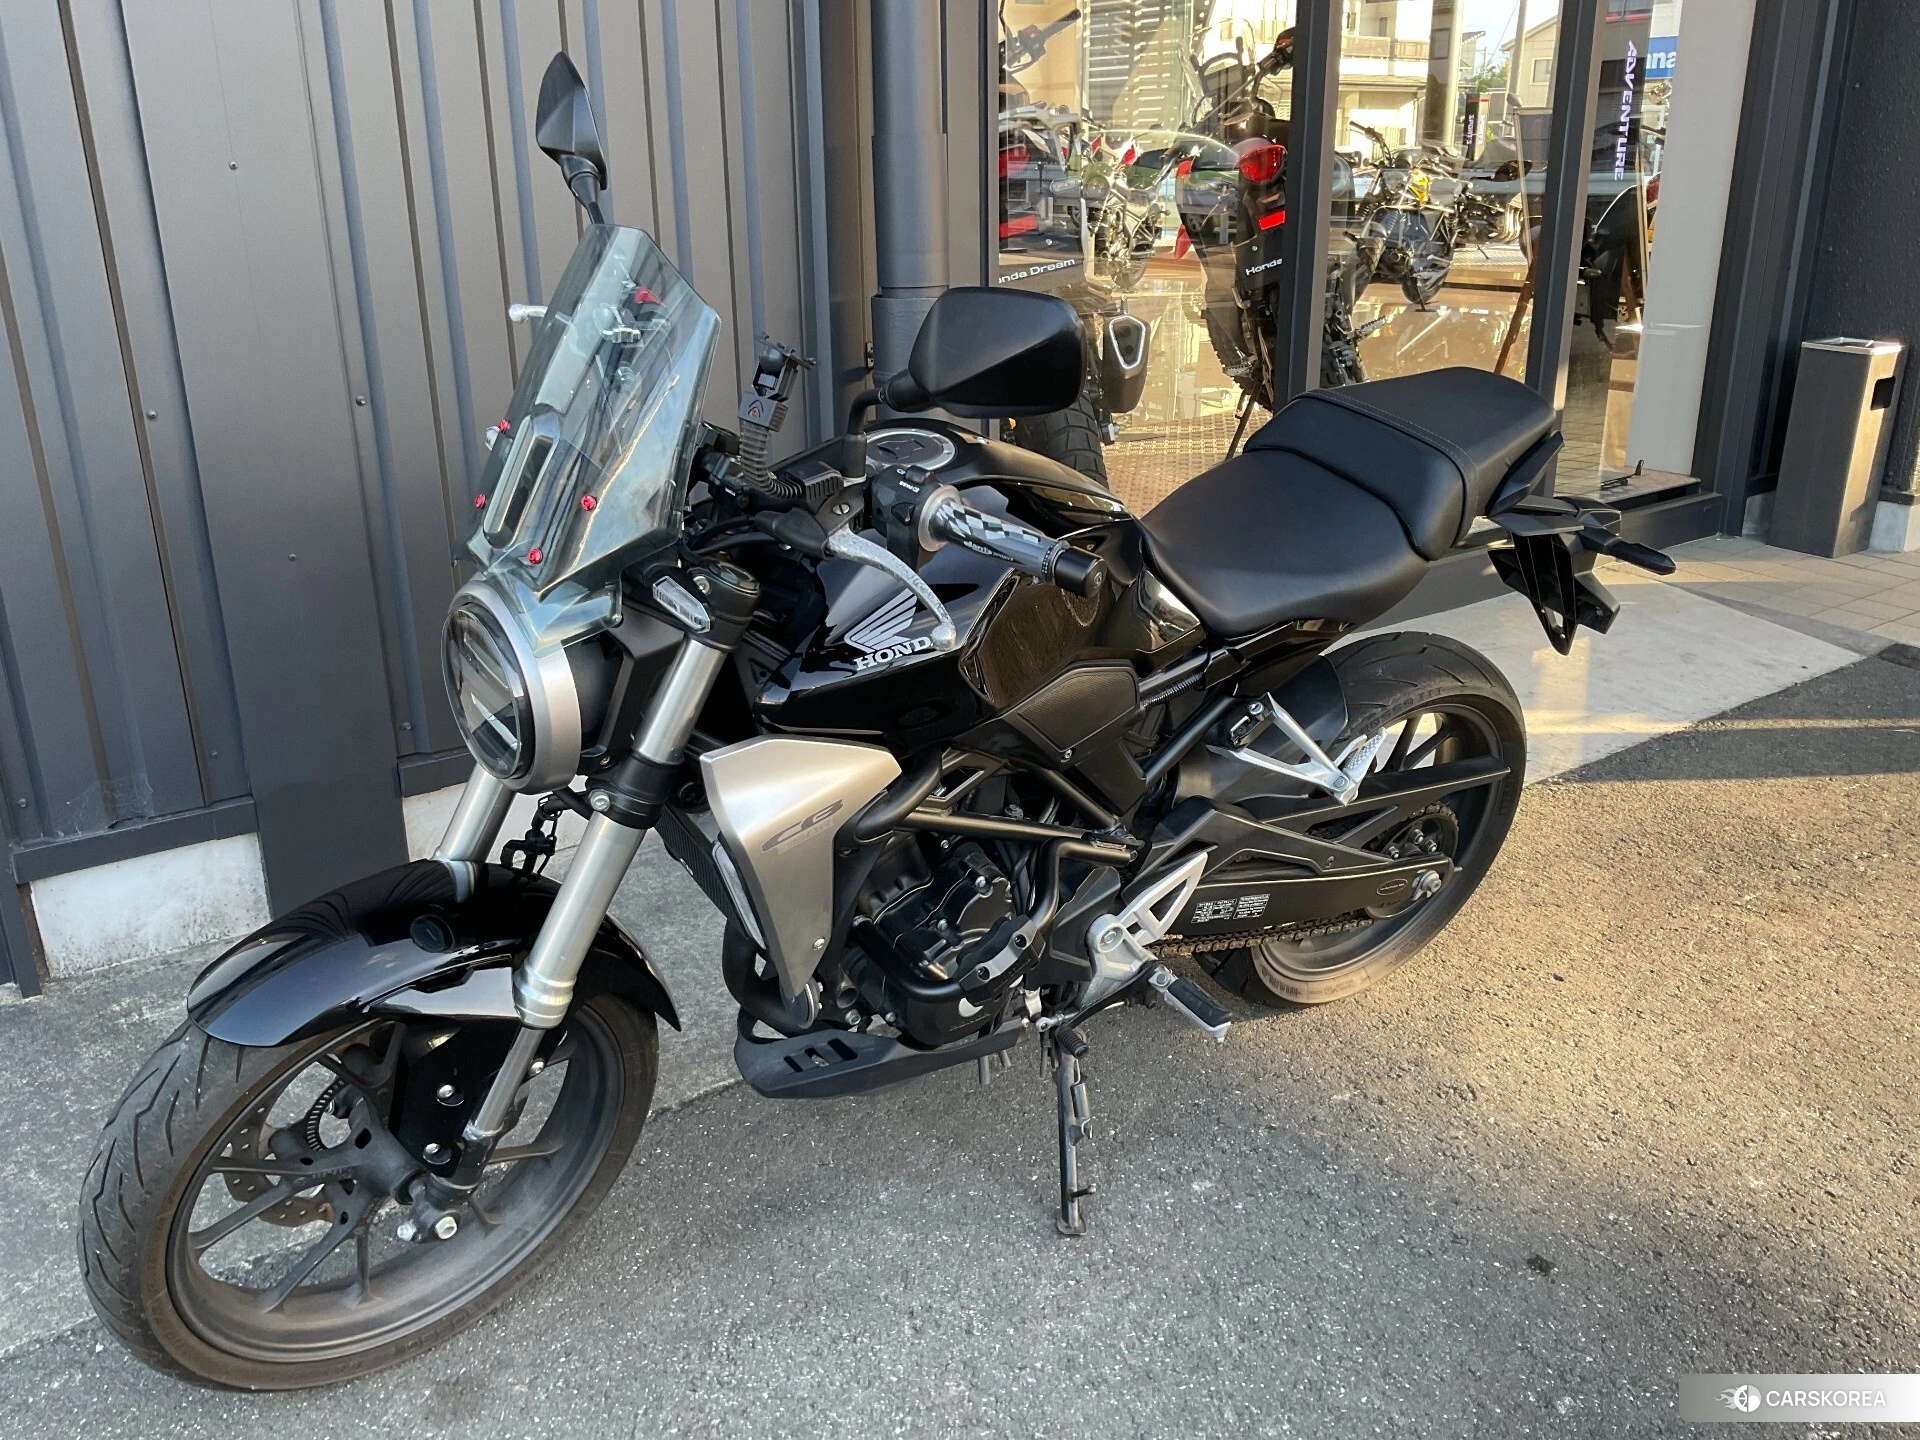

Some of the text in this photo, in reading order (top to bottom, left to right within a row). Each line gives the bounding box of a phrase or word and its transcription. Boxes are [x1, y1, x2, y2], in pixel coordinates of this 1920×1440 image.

[1614, 40, 1638, 181] ADVENTURE
[1029, 258, 1076, 276] Dream
[1245, 258, 1283, 276] Honda
[853, 636, 934, 671] HOND
[761, 798, 844, 853] CB
